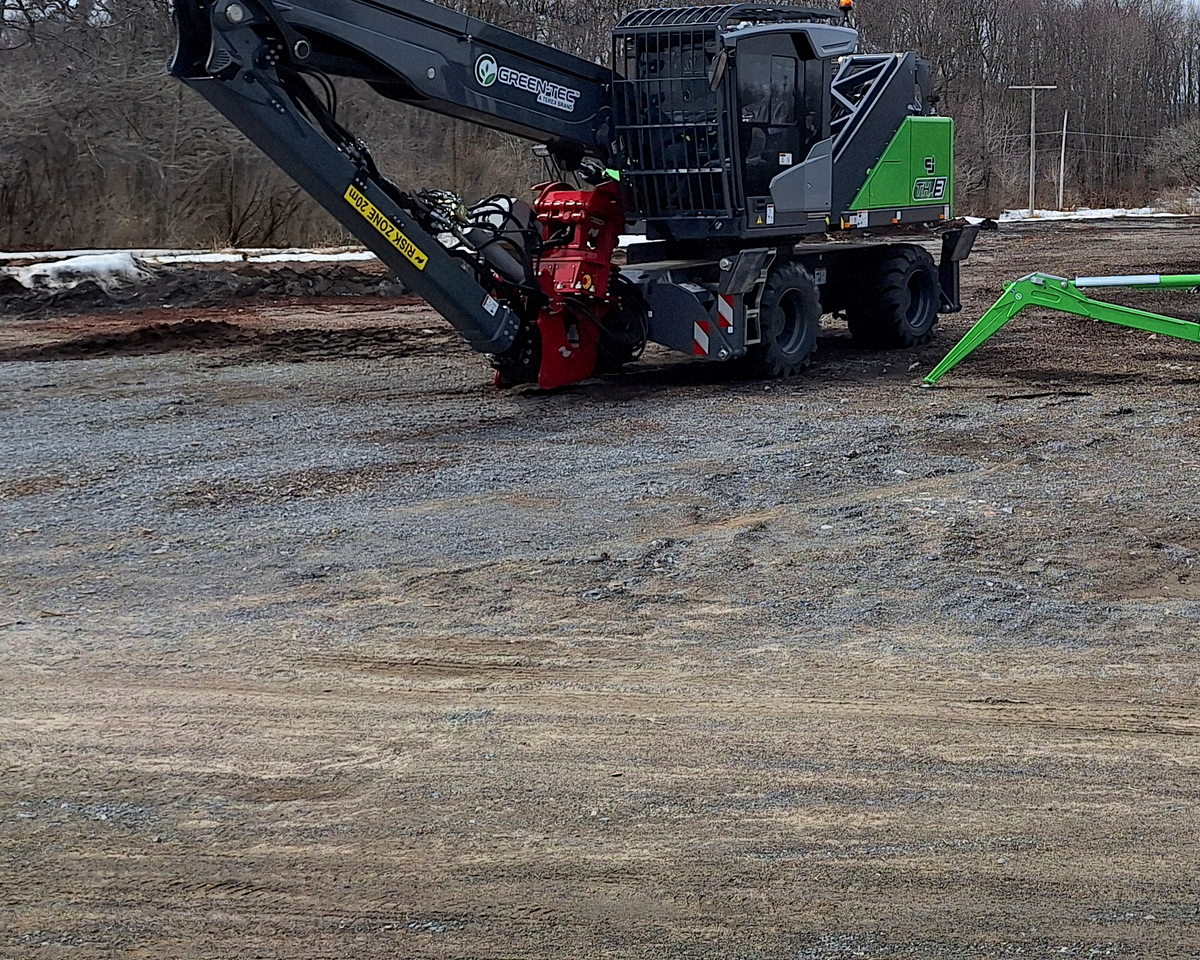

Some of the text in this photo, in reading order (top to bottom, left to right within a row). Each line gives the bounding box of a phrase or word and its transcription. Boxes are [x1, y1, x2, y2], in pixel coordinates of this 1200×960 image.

[499, 66, 577, 103] GREEN-TEC
[349, 188, 416, 258] RISK ZONE 20m
